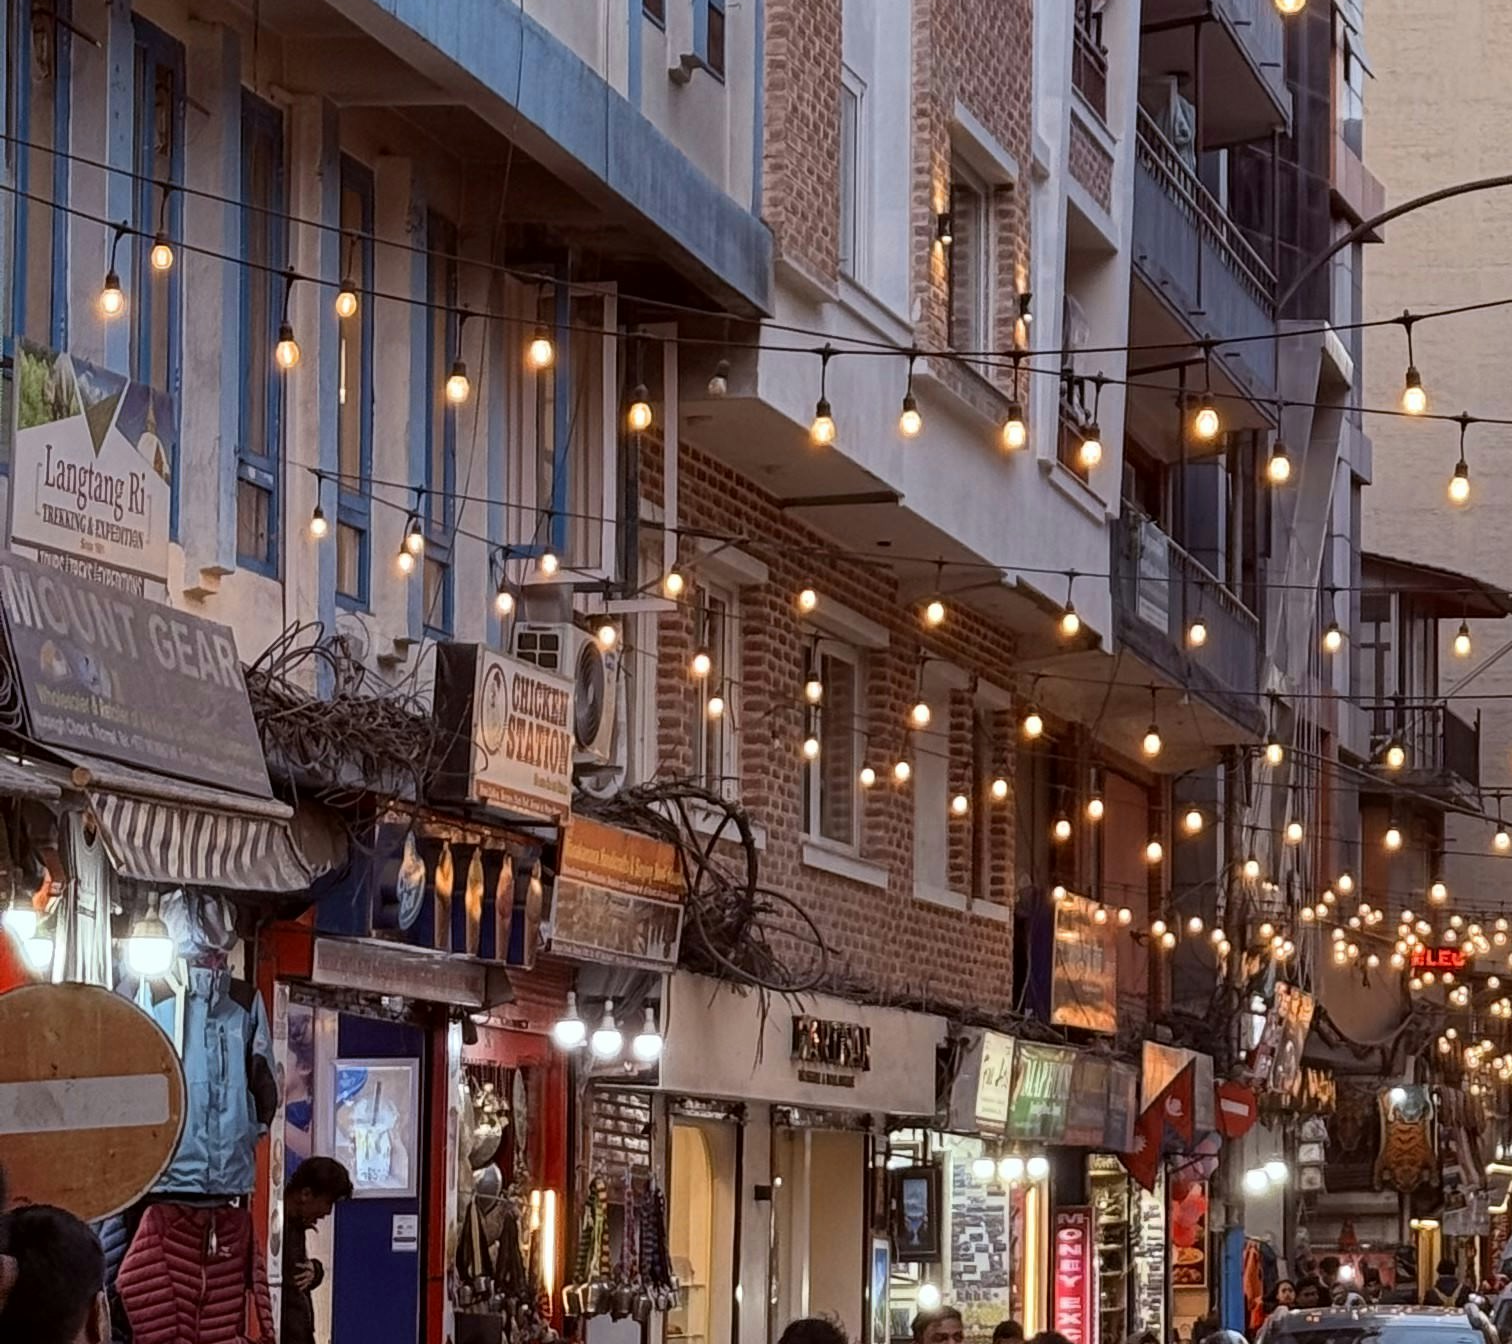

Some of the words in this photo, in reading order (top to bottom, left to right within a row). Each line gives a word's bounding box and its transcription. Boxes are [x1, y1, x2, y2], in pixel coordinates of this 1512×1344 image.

[44, 444, 125, 522] Langtang
[128, 472, 146, 516] Ri
[42, 503, 87, 536] TREKKING
[95, 518, 144, 550] EXPEDITION
[1, 564, 139, 659] MOUNT
[149, 613, 245, 692] GEAR
[511, 672, 570, 727] CHICKEN
[506, 713, 571, 776] STATION
[1057, 1213, 1084, 1288] MONEY
